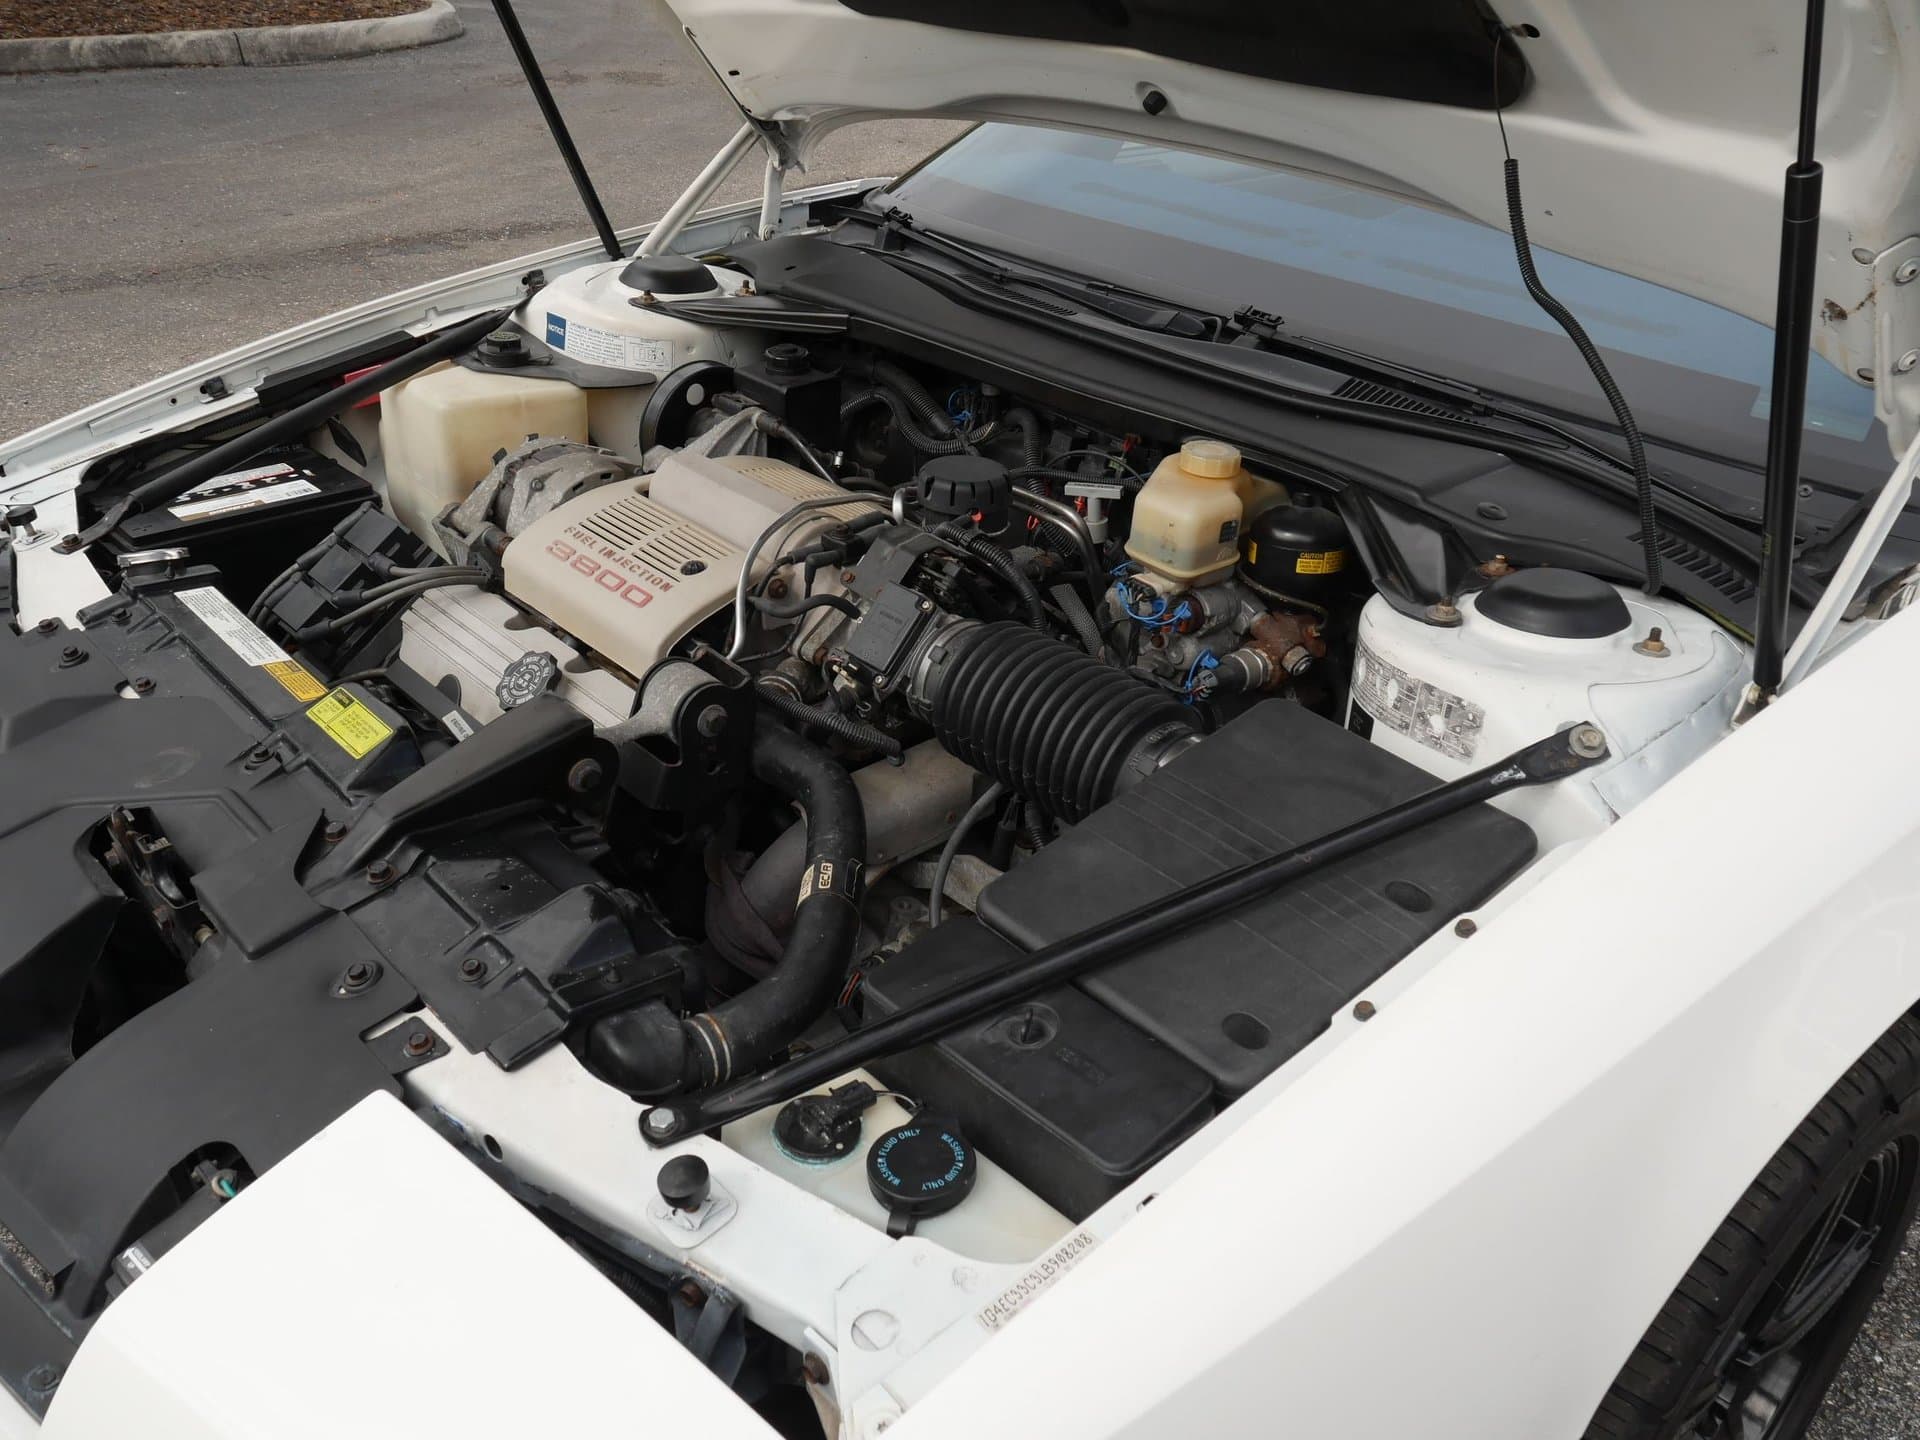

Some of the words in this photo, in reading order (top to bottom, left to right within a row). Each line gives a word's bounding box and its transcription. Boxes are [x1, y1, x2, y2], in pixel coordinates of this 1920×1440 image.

[547, 323, 565, 337] NOTICE
[563, 526, 598, 549] FUEL
[598, 546, 675, 593] INJECTION
[1299, 552, 1324, 560] CAUTION
[545, 539, 654, 609] 3800
[898, 1128, 921, 1140] ONLY
[878, 1138, 898, 1157] FLUID
[941, 1133, 965, 1164] WASHER
[877, 1157, 902, 1186] WASHER
[945, 1163, 964, 1182] FLUID
[922, 1179, 945, 1191] ONLY
